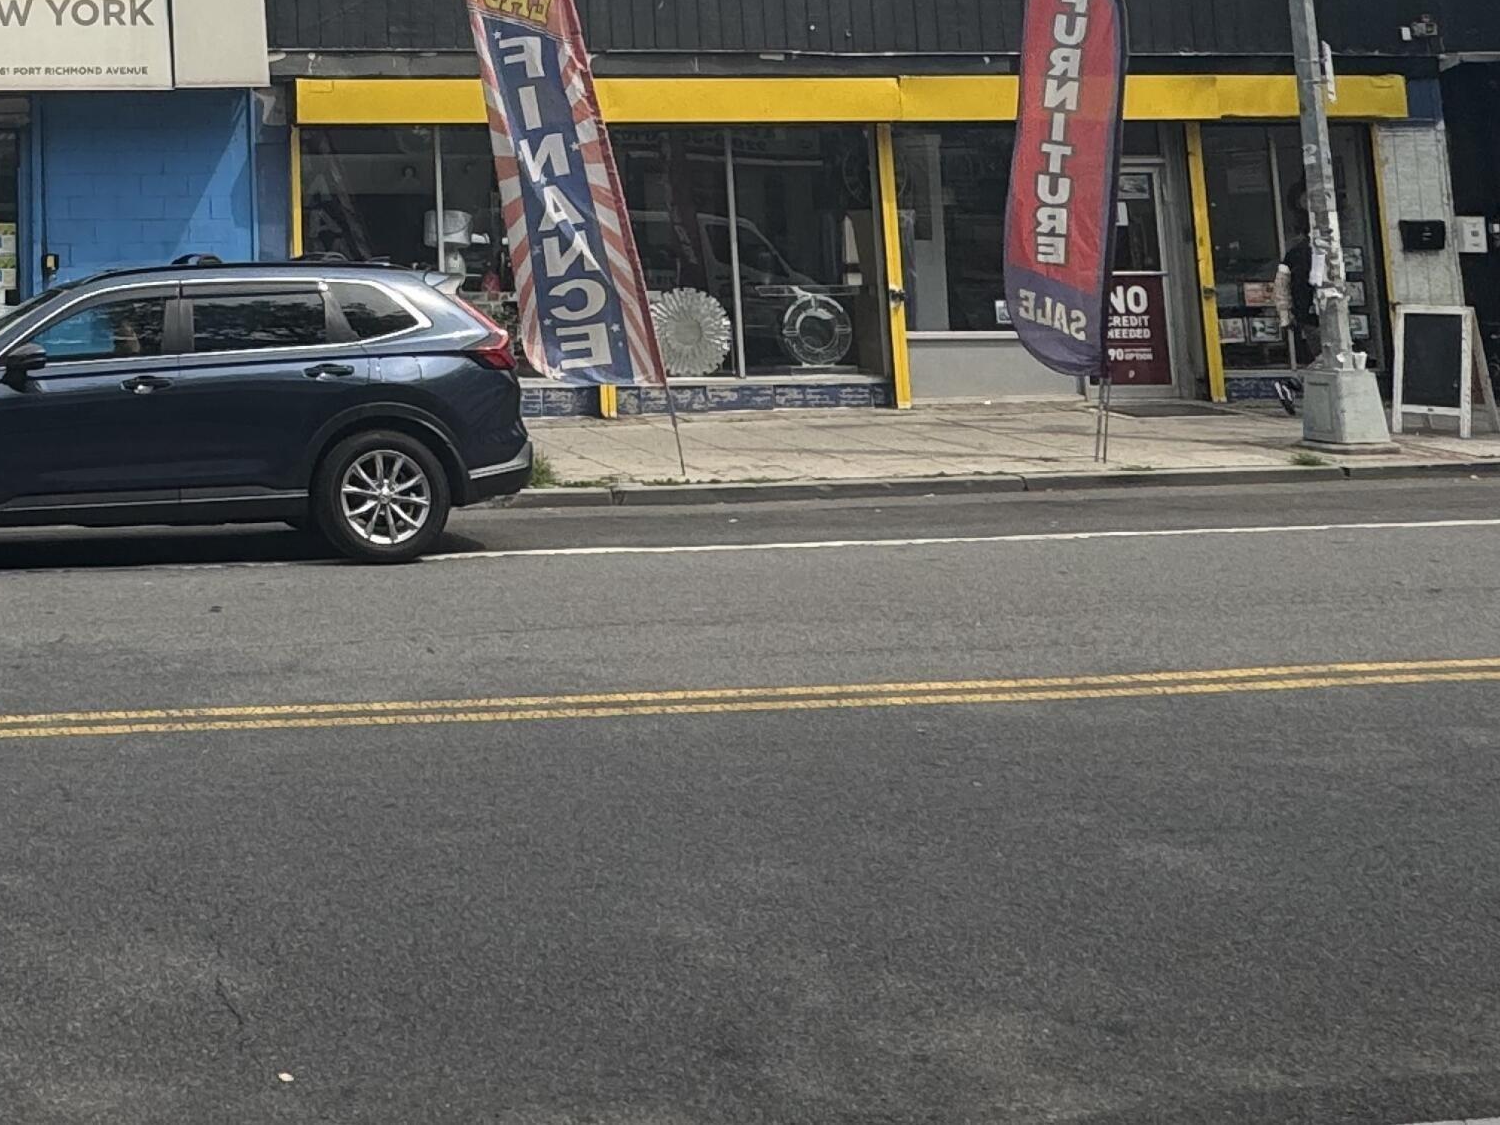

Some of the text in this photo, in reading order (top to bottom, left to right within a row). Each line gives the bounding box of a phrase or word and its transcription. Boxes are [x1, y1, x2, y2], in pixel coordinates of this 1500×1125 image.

[13, 66, 42, 76] PORT
[44, 66, 103, 76] RICHMOND
[105, 65, 149, 76] AVENUE
[1109, 285, 1149, 315] NO
[1108, 315, 1150, 328] CREDIT
[1107, 328, 1151, 339] NEEDED
